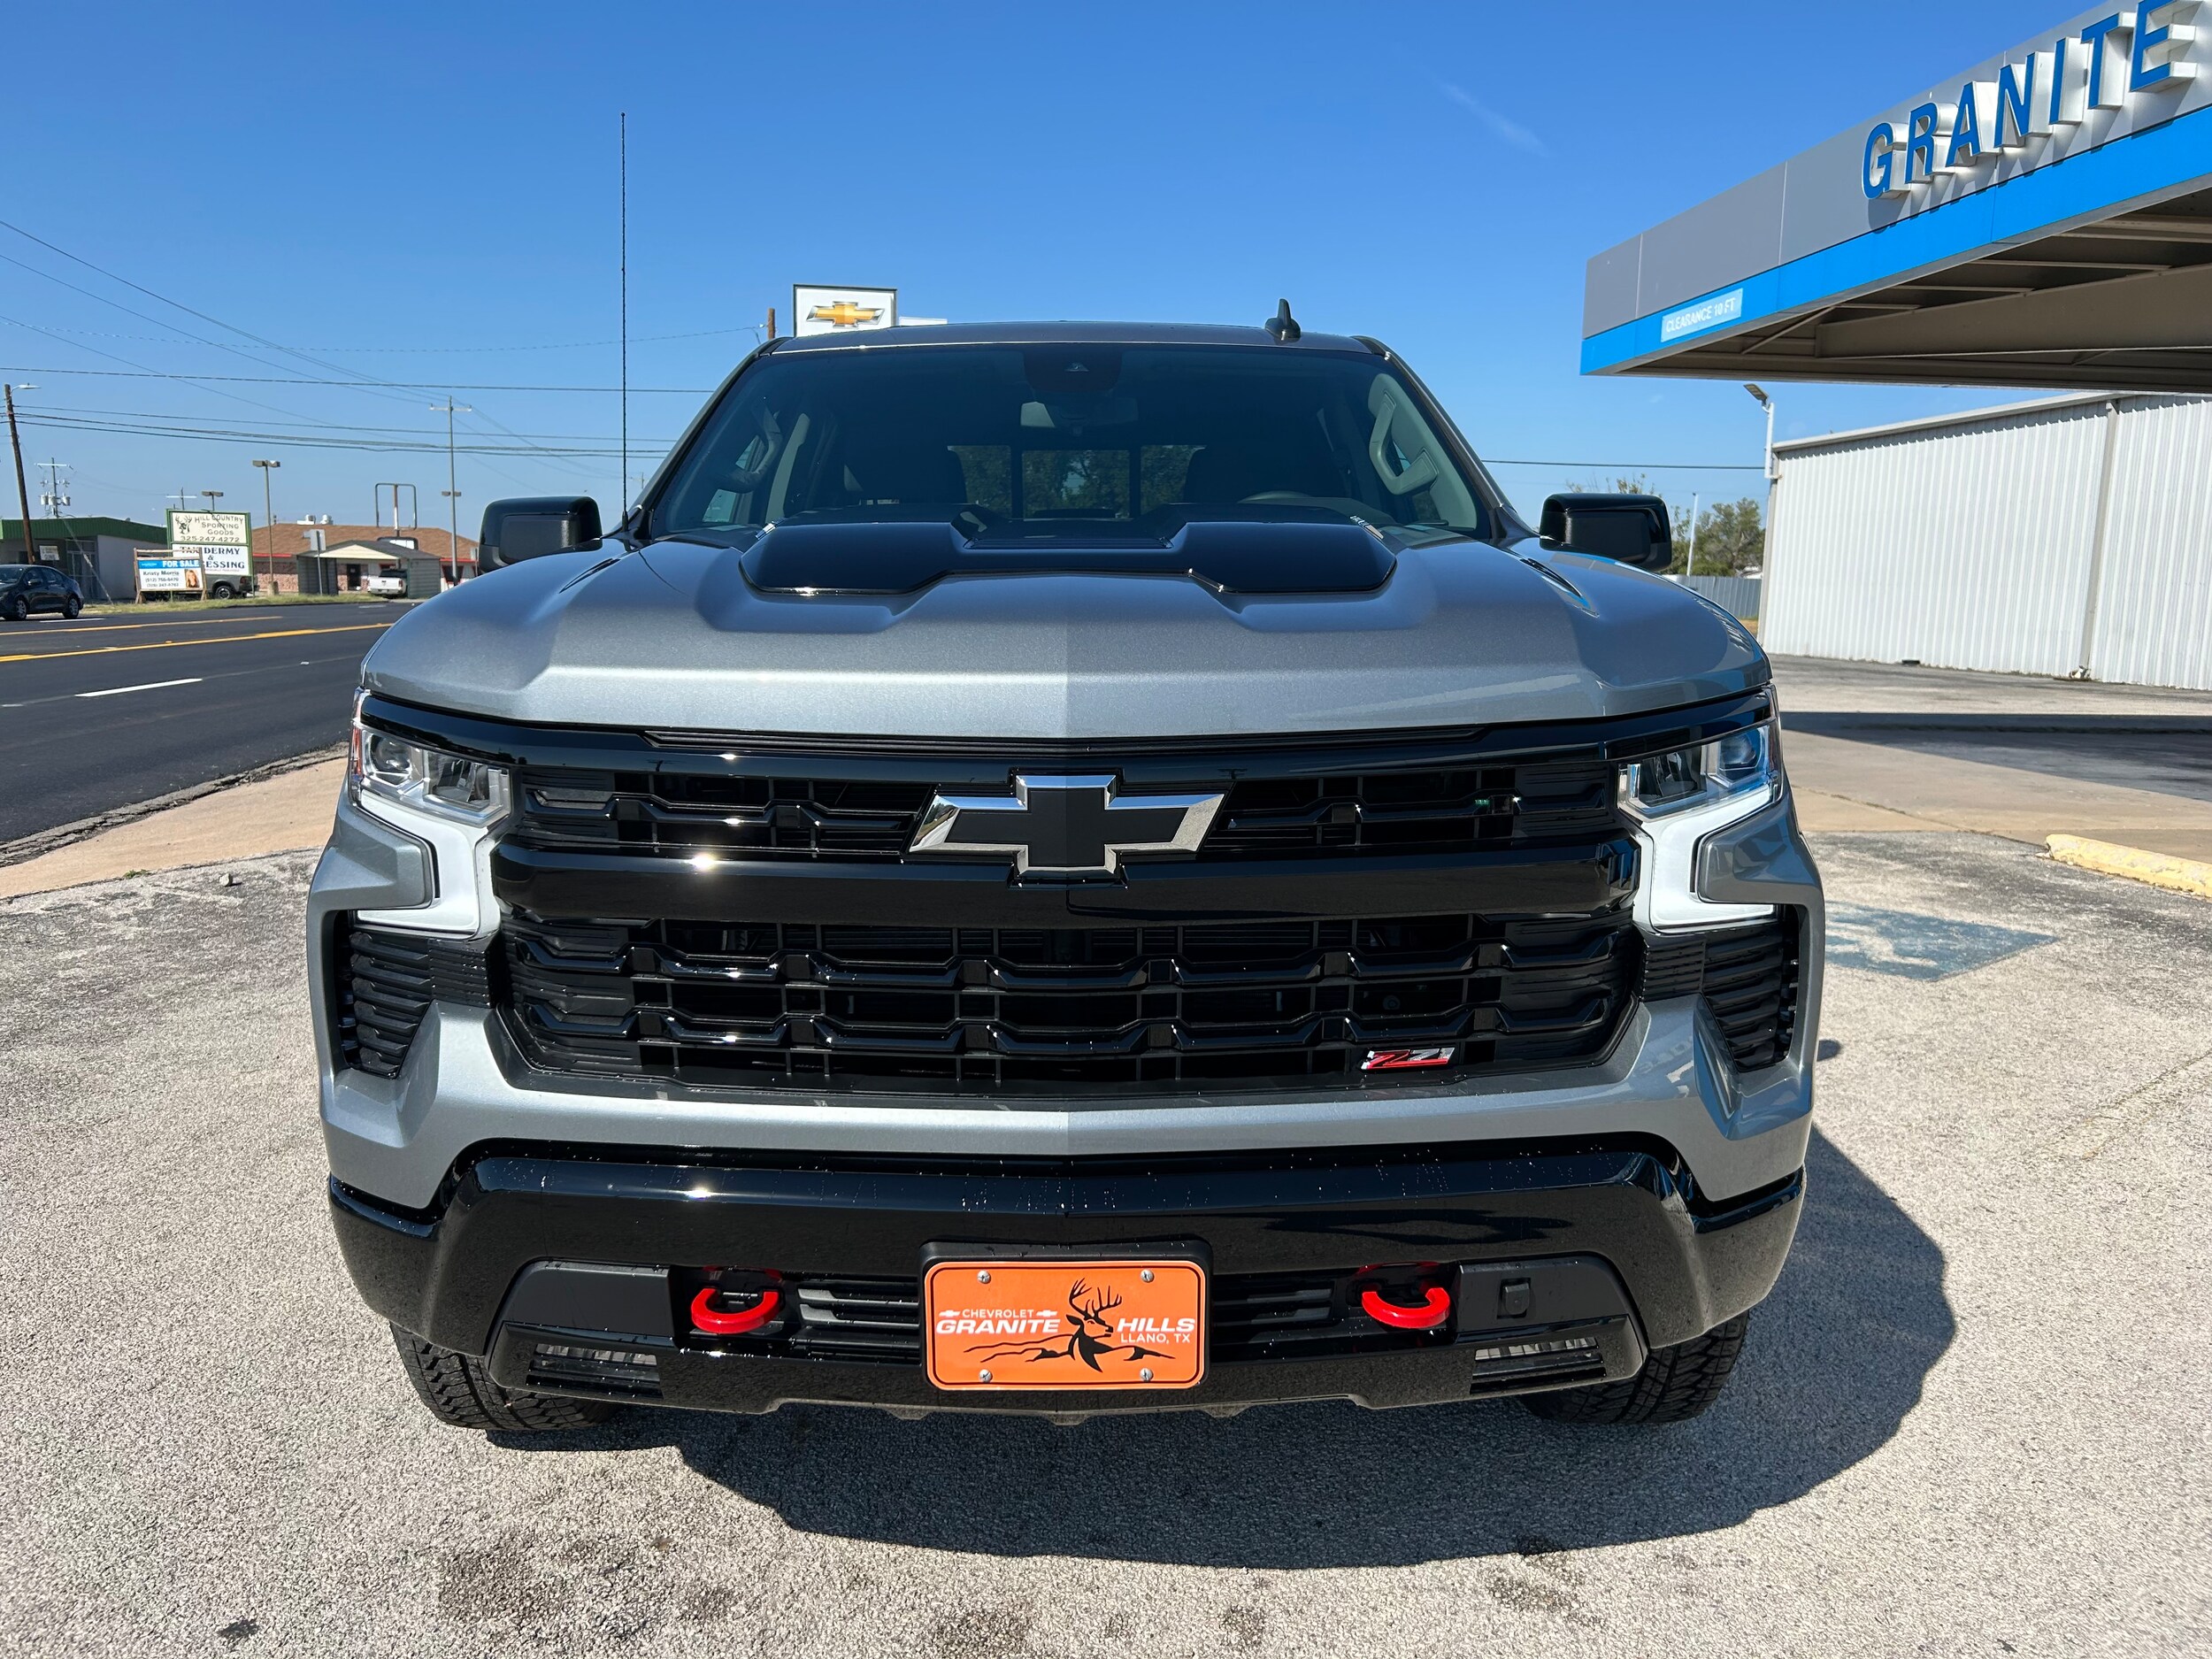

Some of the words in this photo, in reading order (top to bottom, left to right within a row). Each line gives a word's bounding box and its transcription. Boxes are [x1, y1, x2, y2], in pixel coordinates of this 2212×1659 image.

[1862, 0, 2187, 200] GRANITE
[1665, 305, 1712, 333] CLEARANCE
[1714, 303, 1724, 317] 10
[1724, 297, 1736, 314] FT
[212, 514, 243, 525] COUNTRY
[180, 546, 240, 555] TAXDERMY
[1361, 1048, 1455, 1070] Z71
[962, 1309, 1034, 1318] CHEVROLET
[936, 1319, 1061, 1334] GRANITE
[1117, 1317, 1196, 1333] HILLS
[1120, 1333, 1170, 1345] LLANO,
[1173, 1333, 1191, 1343] TX
